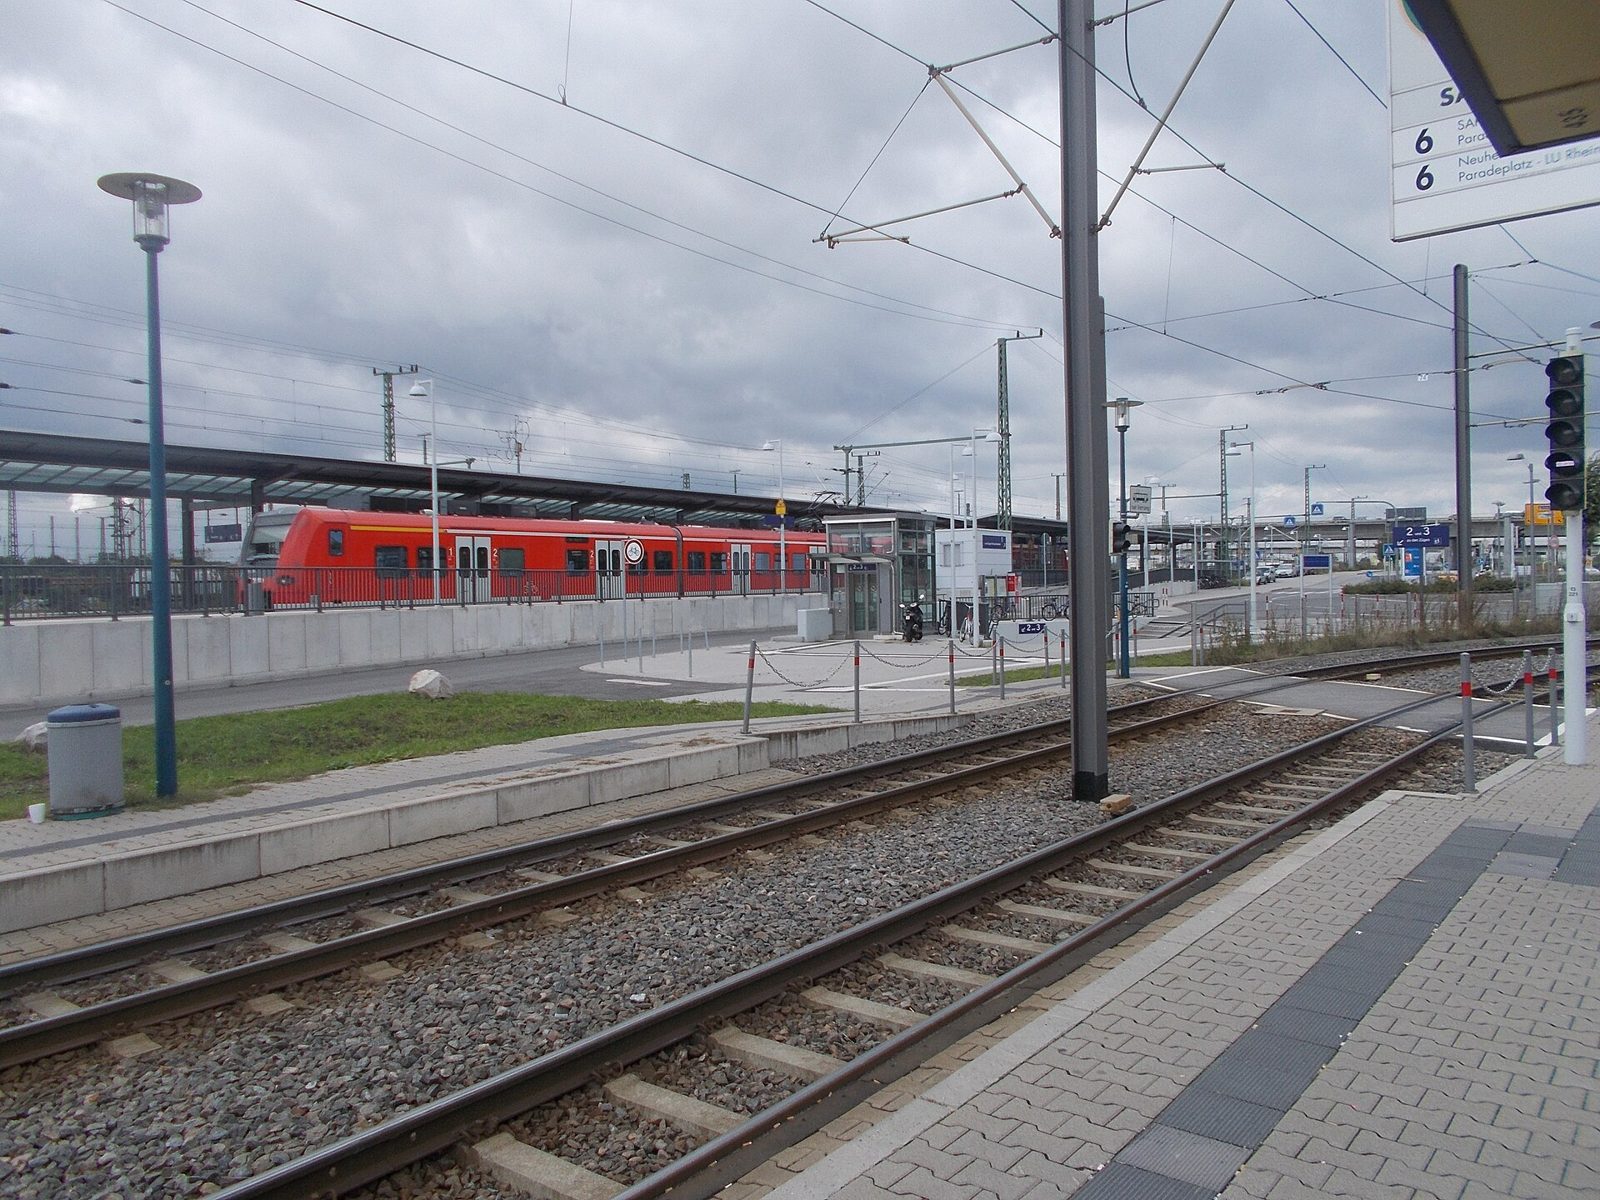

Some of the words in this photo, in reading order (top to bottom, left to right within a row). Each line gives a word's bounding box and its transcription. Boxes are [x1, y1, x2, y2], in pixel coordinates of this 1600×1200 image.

[1415, 127, 1433, 154] 6
[1457, 133, 1485, 145] Para
[1458, 150, 1499, 167] Neuhe
[1458, 160, 1533, 182] Paradeplatz
[1416, 163, 1434, 191] 6
[1406, 526, 1413, 536] 2
[1423, 526, 1430, 536] 3
[448, 547, 453, 556] 1
[492, 548, 498, 557] 2
[590, 550, 595, 558] 2
[1036, 623, 1041, 631] 3
